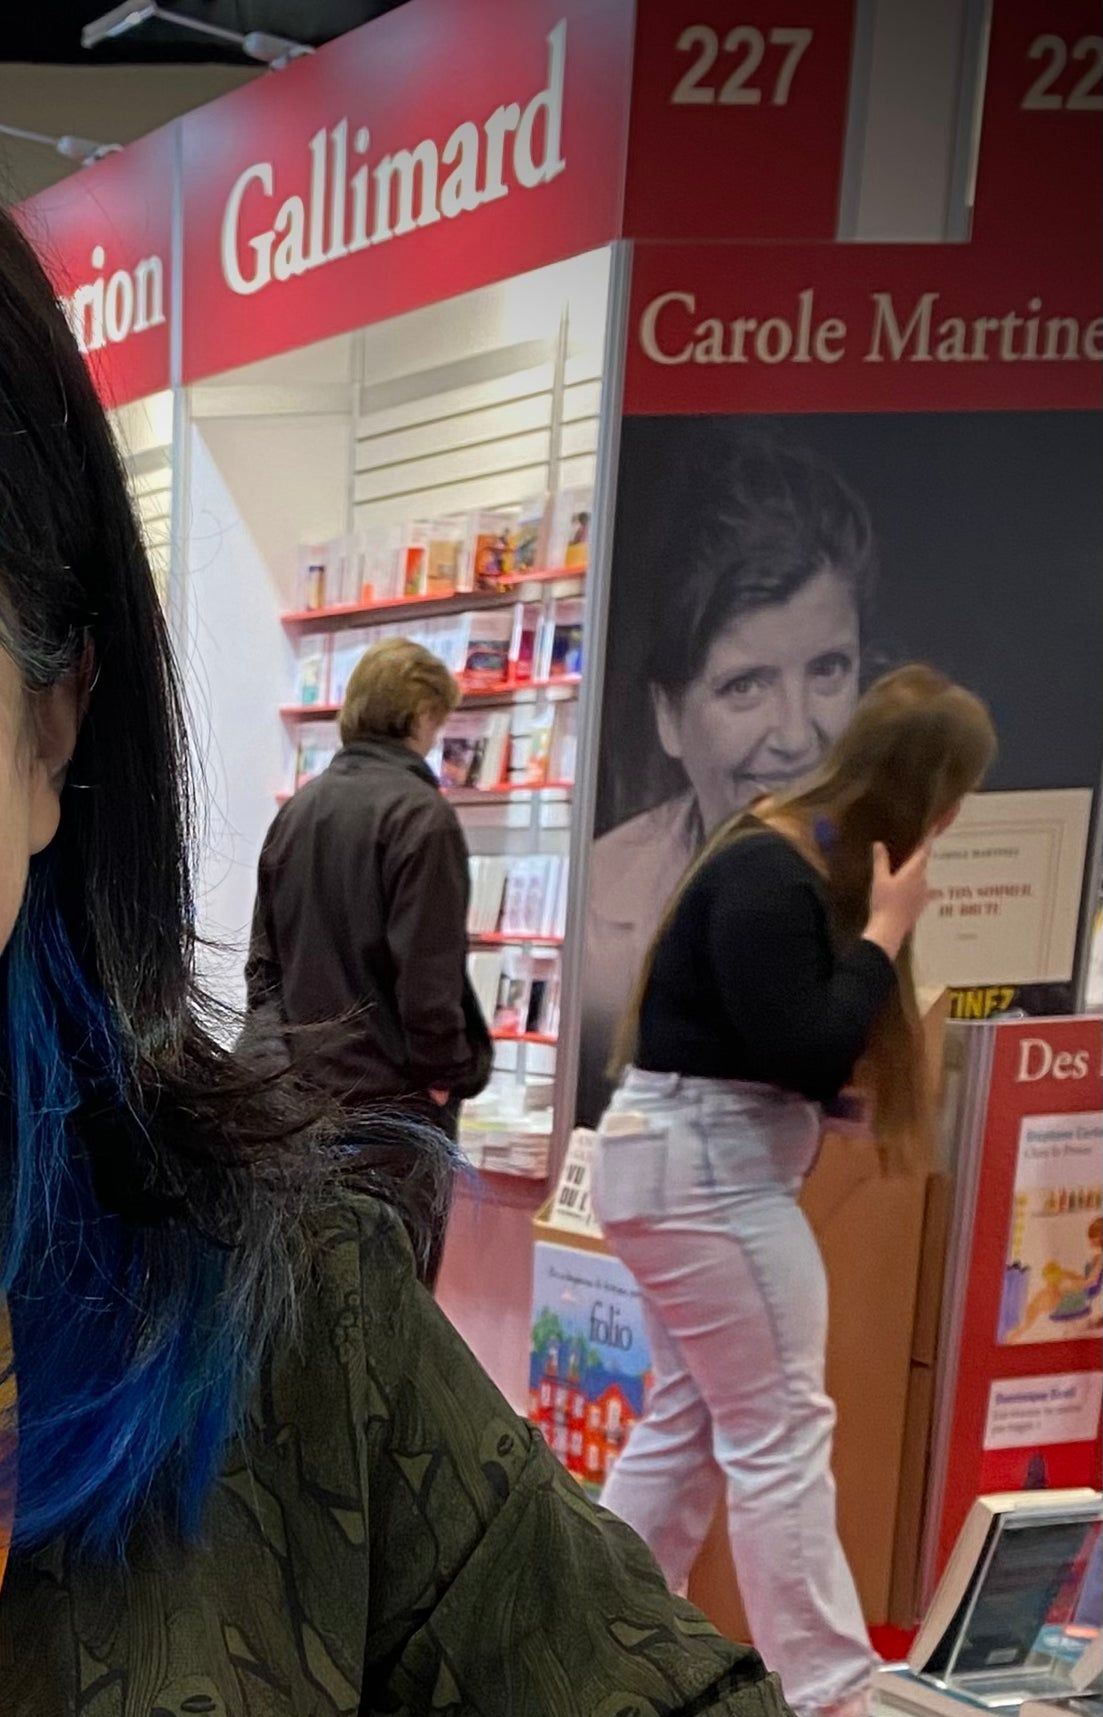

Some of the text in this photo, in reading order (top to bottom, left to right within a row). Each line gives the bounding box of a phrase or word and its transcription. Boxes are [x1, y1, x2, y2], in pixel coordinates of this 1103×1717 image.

[671, 27, 813, 107] 227
[221, 19, 568, 297] Gallimard
[69, 245, 165, 356] rion
[640, 292, 848, 365] Carole
[1018, 1038, 1089, 1083] Des
[590, 1301, 633, 1351] folio
